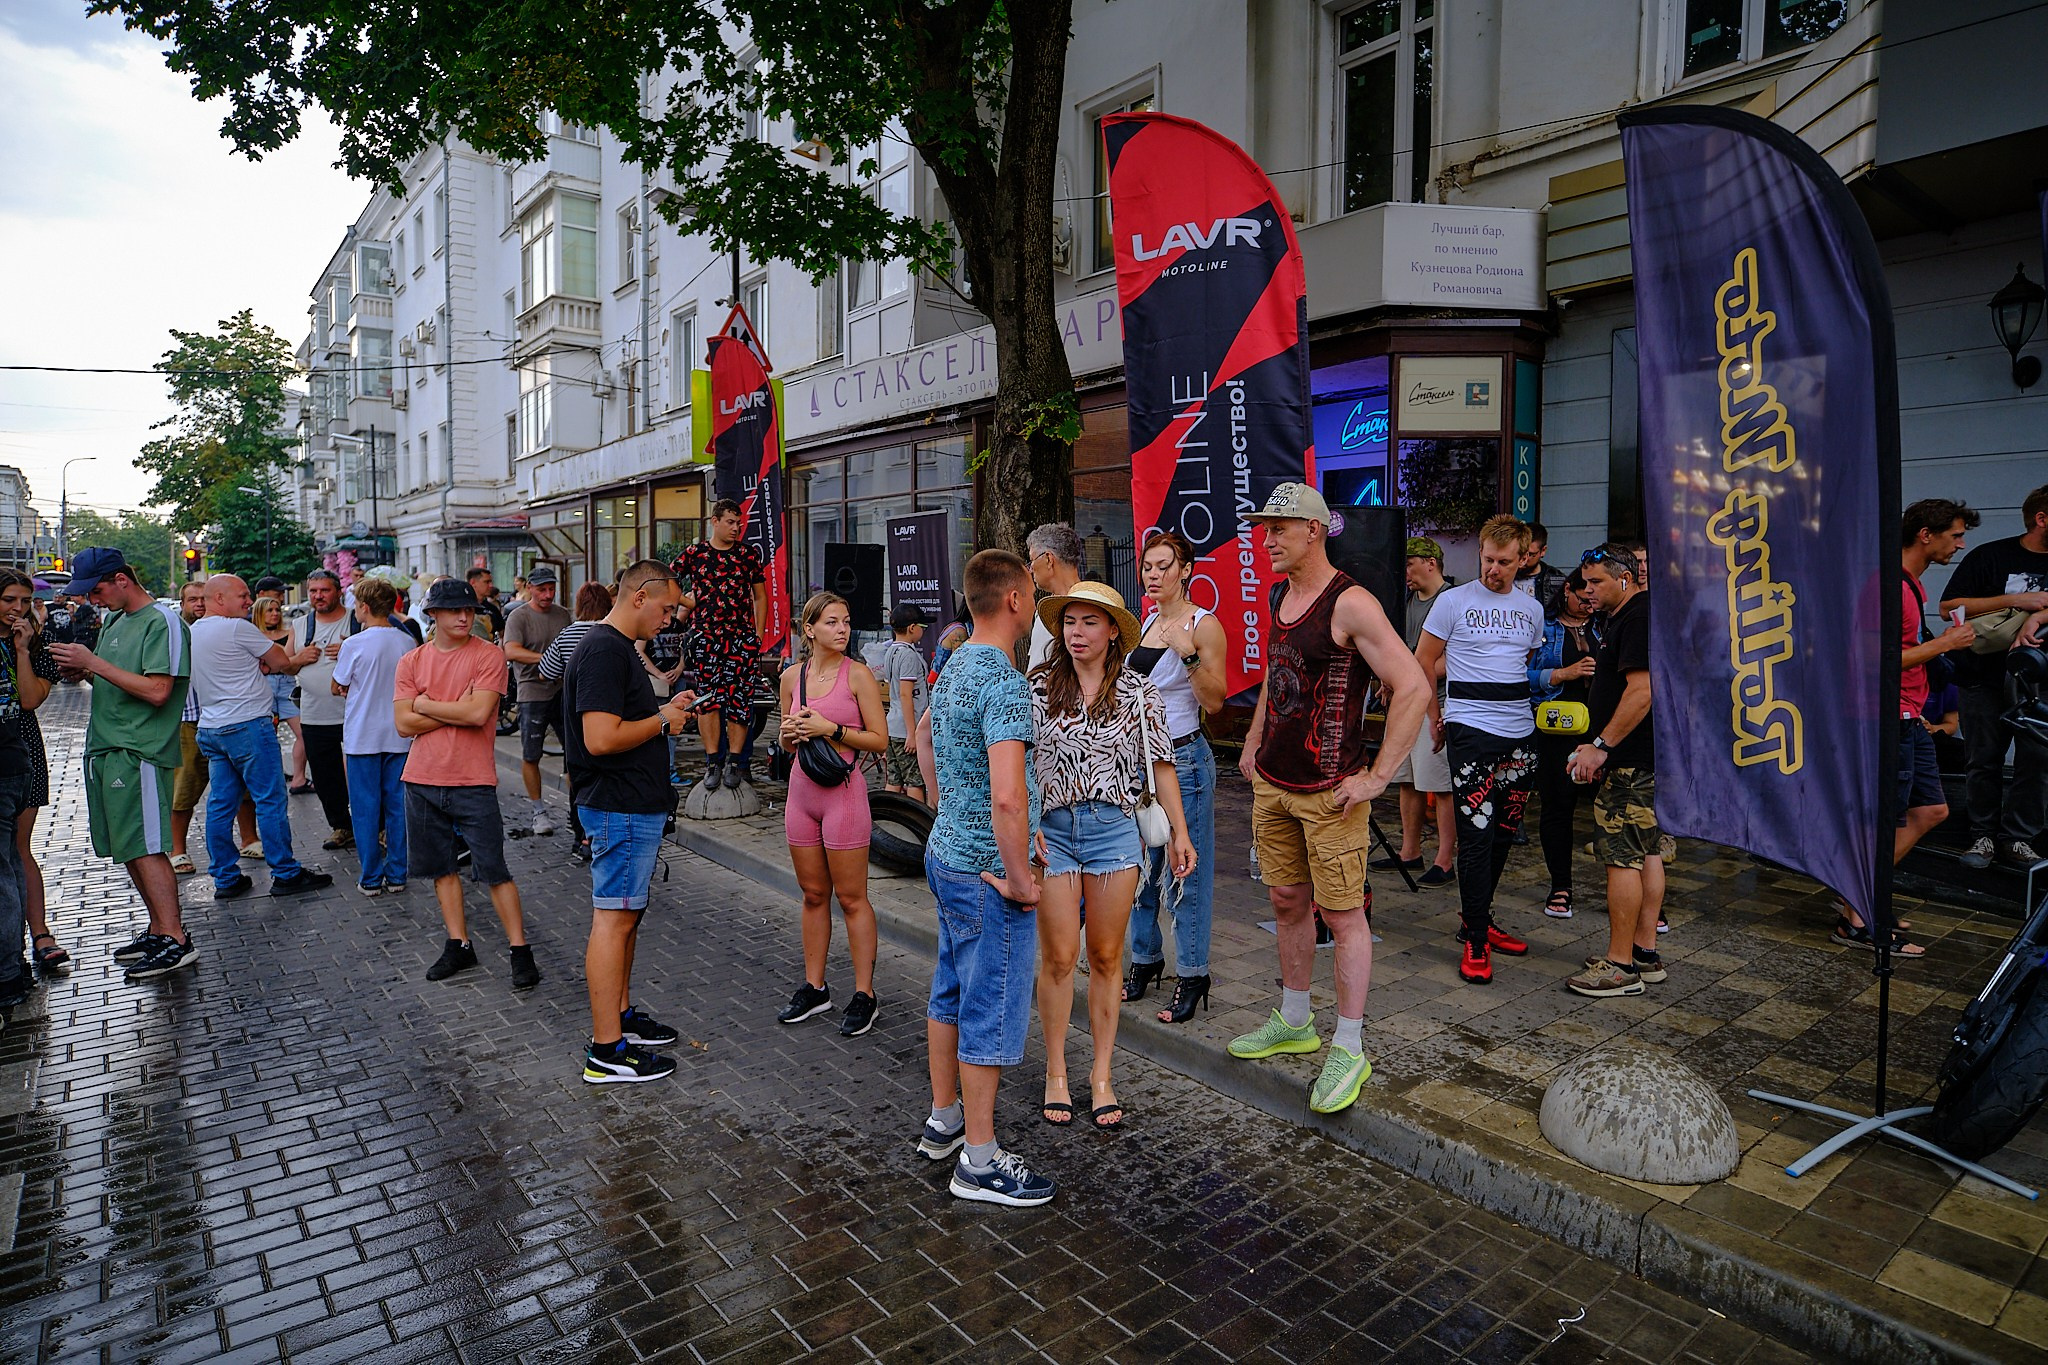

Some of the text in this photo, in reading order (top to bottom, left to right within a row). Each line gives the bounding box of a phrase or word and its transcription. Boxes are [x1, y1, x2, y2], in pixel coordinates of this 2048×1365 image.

[1431, 222, 1505, 239] Лучший бар,
[1434, 244, 1498, 256] по мнению
[1161, 260, 1229, 279] MOTOLINE
[1411, 261, 1524, 278] Кузнецова Родиона
[1433, 282, 1503, 296] Романовича
[833, 298, 1117, 408] СТАКСЕЛ АР
[899, 387, 948, 409] СТАКСЕЛЬ
[957, 380, 977, 396] ЭТО
[1341, 399, 1389, 449] Стак
[1517, 445, 1530, 516] КОФ
[1225, 378, 1261, 674] Твое преимущество!
[896, 564, 918, 576] LAVR
[898, 579, 940, 592] MOTOLINE
[770, 599, 781, 637] Твое
[1003, 714, 1026, 725] GAP
[1005, 706, 1028, 716] GAP
